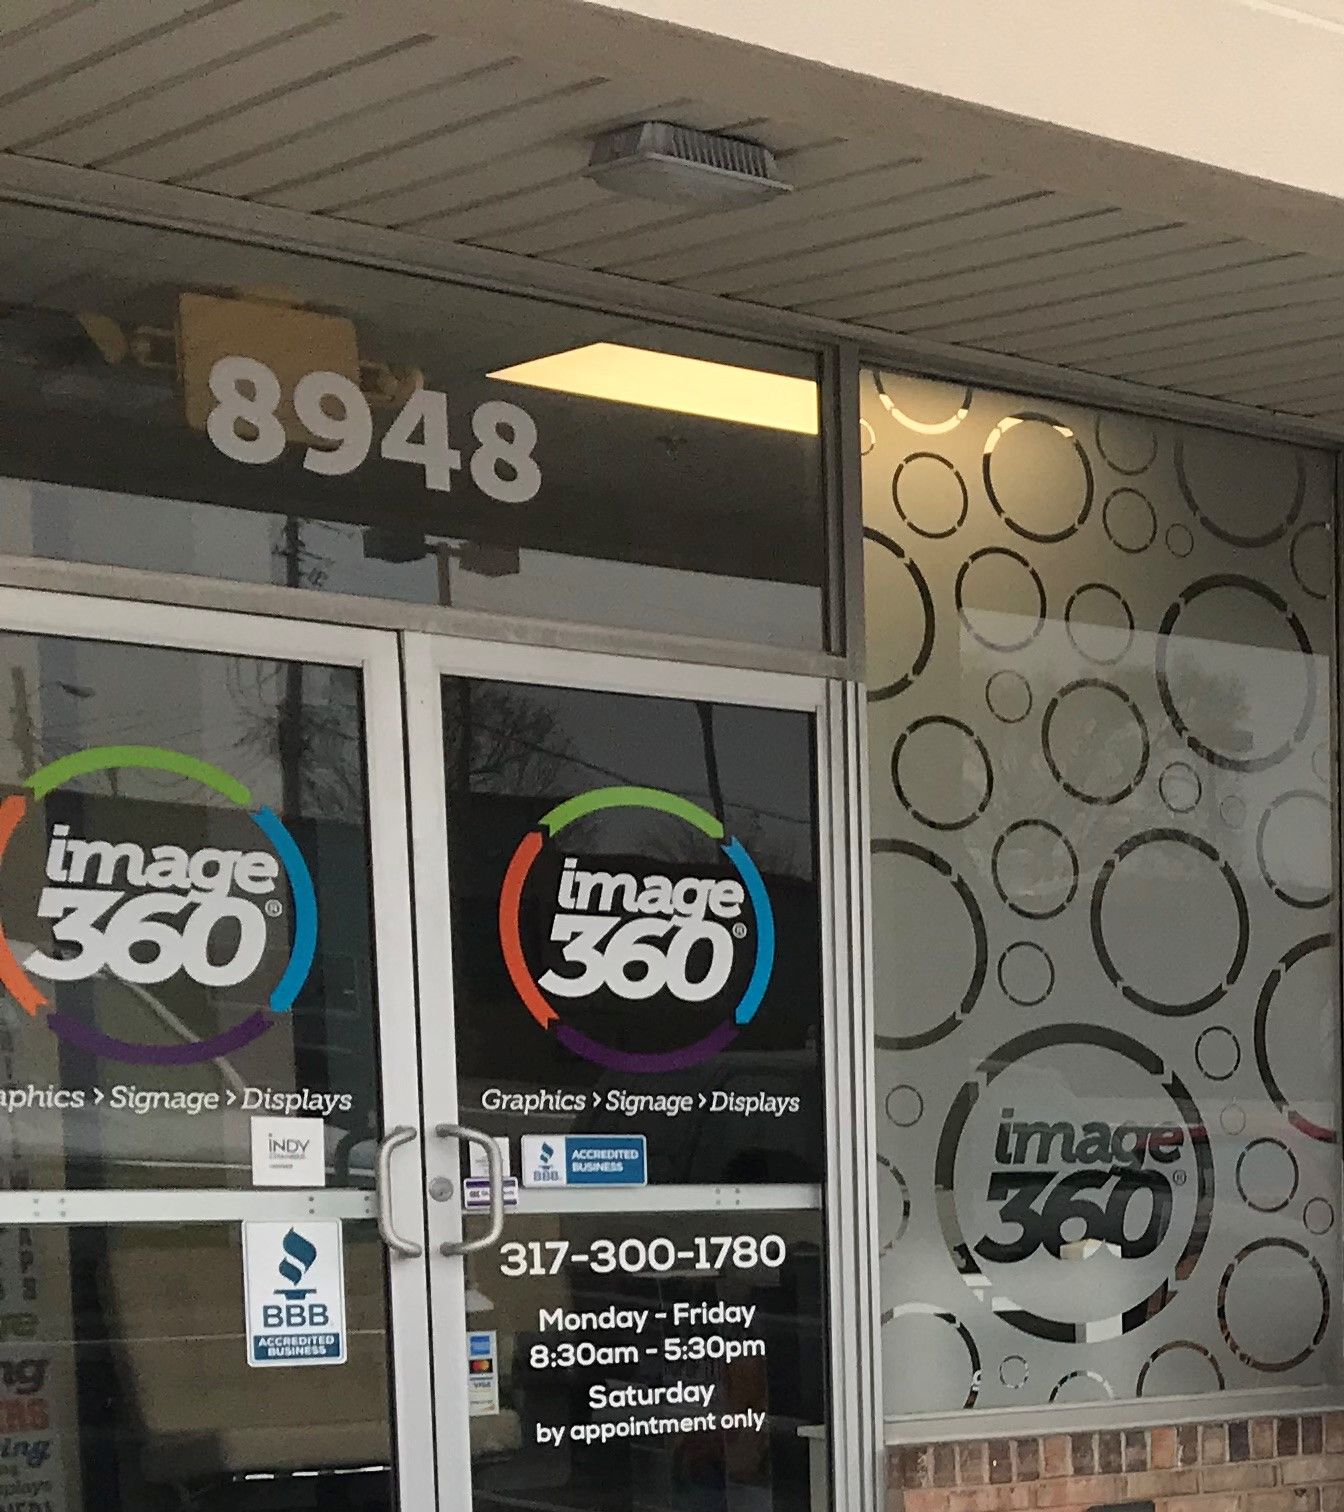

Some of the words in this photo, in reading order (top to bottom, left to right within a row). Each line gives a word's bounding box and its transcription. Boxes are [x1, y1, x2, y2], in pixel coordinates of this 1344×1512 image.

[207, 355, 541, 502] 8948
[46, 825, 279, 895] image
[557, 857, 745, 918] image
[22, 888, 266, 988] 360
[538, 914, 733, 1002] 360
[110, 1085, 219, 1114] Signage
[241, 1088, 352, 1115] Displays
[481, 1088, 585, 1113] Graphics
[606, 1090, 693, 1116] Signage
[710, 1091, 800, 1117] Displays
[572, 1149, 639, 1160] ACCREDITED
[994, 1108, 1184, 1170] image
[572, 1161, 624, 1172] BUSINESS
[973, 1166, 1173, 1263] 360
[499, 1234, 786, 1276] 317-300-1780
[263, 1303, 329, 1327] BBB
[539, 1305, 648, 1333] Monday
[673, 1301, 756, 1328] Friday
[258, 1335, 334, 1347] ACCREDITED
[267, 1345, 327, 1357] BUSINESS
[529, 1343, 639, 1368] 8:30am
[664, 1336, 766, 1363] 5:30pm
[588, 1381, 715, 1409] Saturday
[536, 1421, 562, 1446] by
[570, 1412, 716, 1444] appointment
[721, 1409, 766, 1431] only
